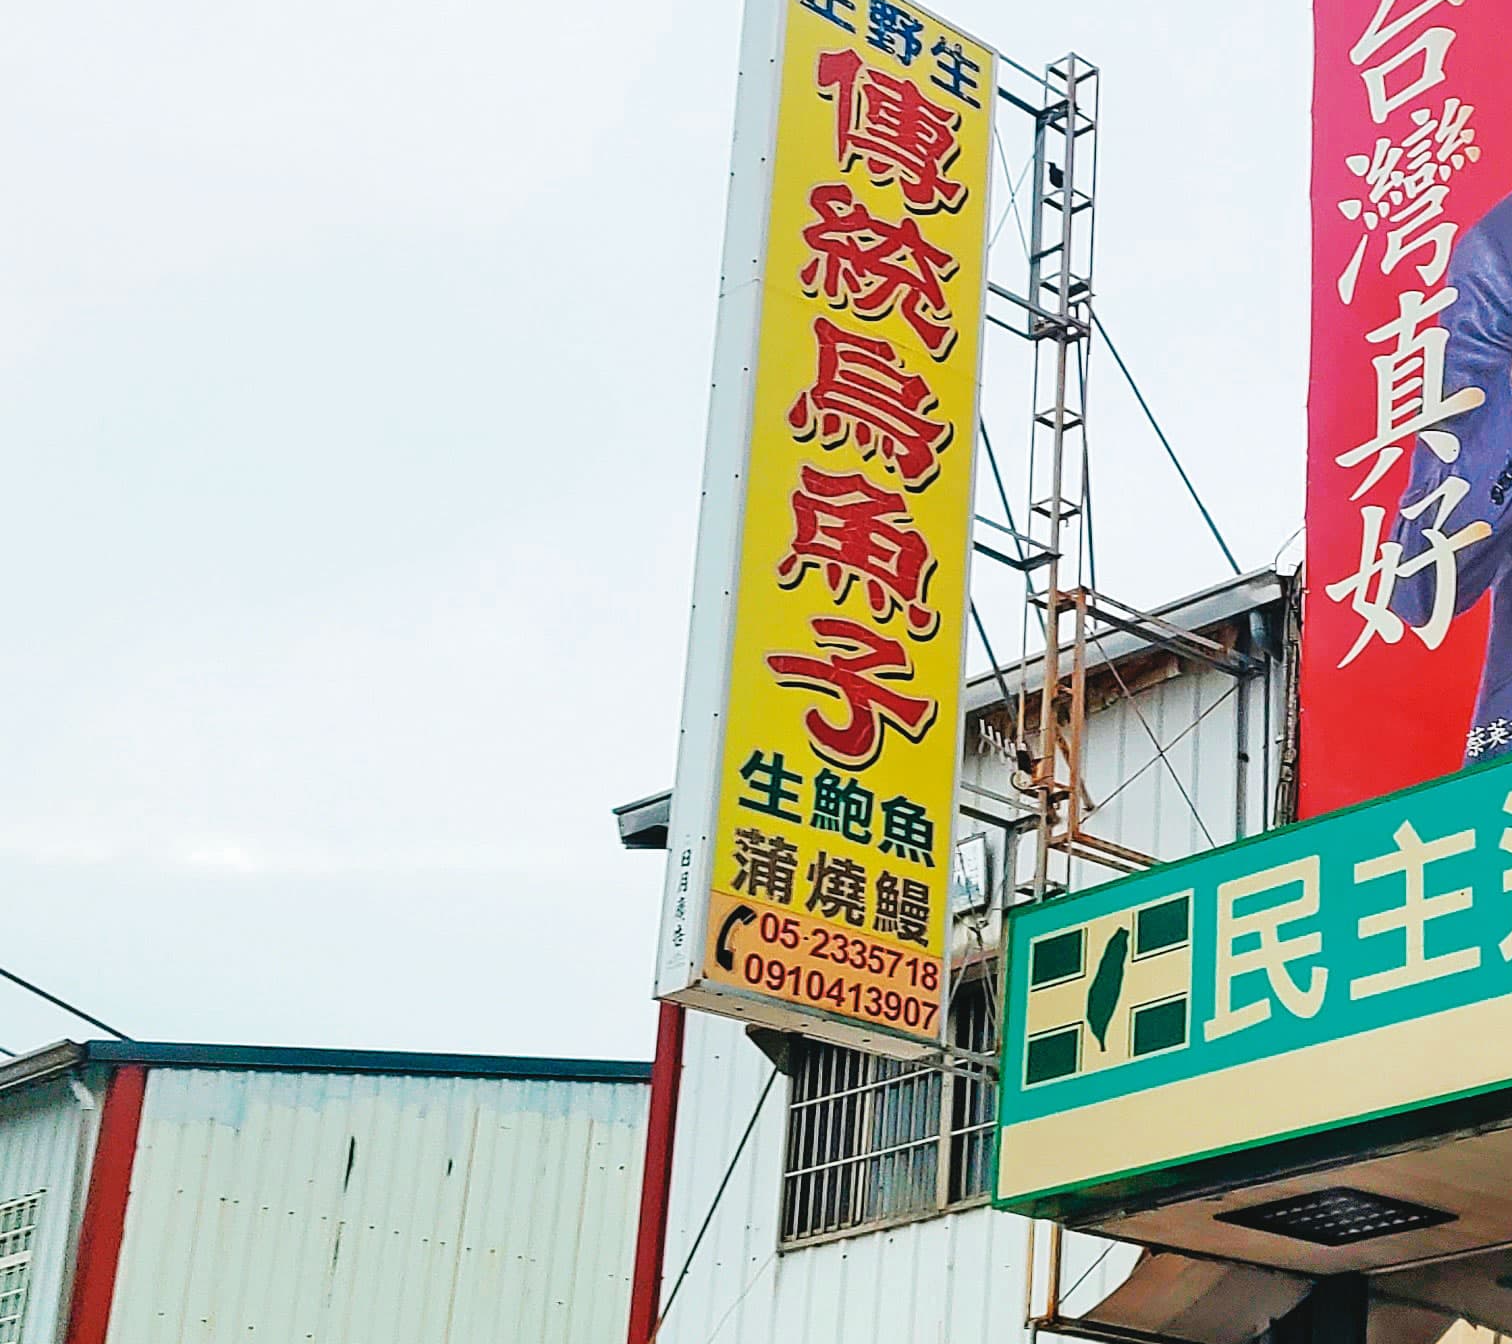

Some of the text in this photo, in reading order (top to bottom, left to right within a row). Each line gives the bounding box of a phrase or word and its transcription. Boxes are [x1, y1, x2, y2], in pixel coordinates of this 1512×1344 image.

[738, 749, 937, 869] 生鮑魚
[744, 952, 940, 1033] 0910413907
